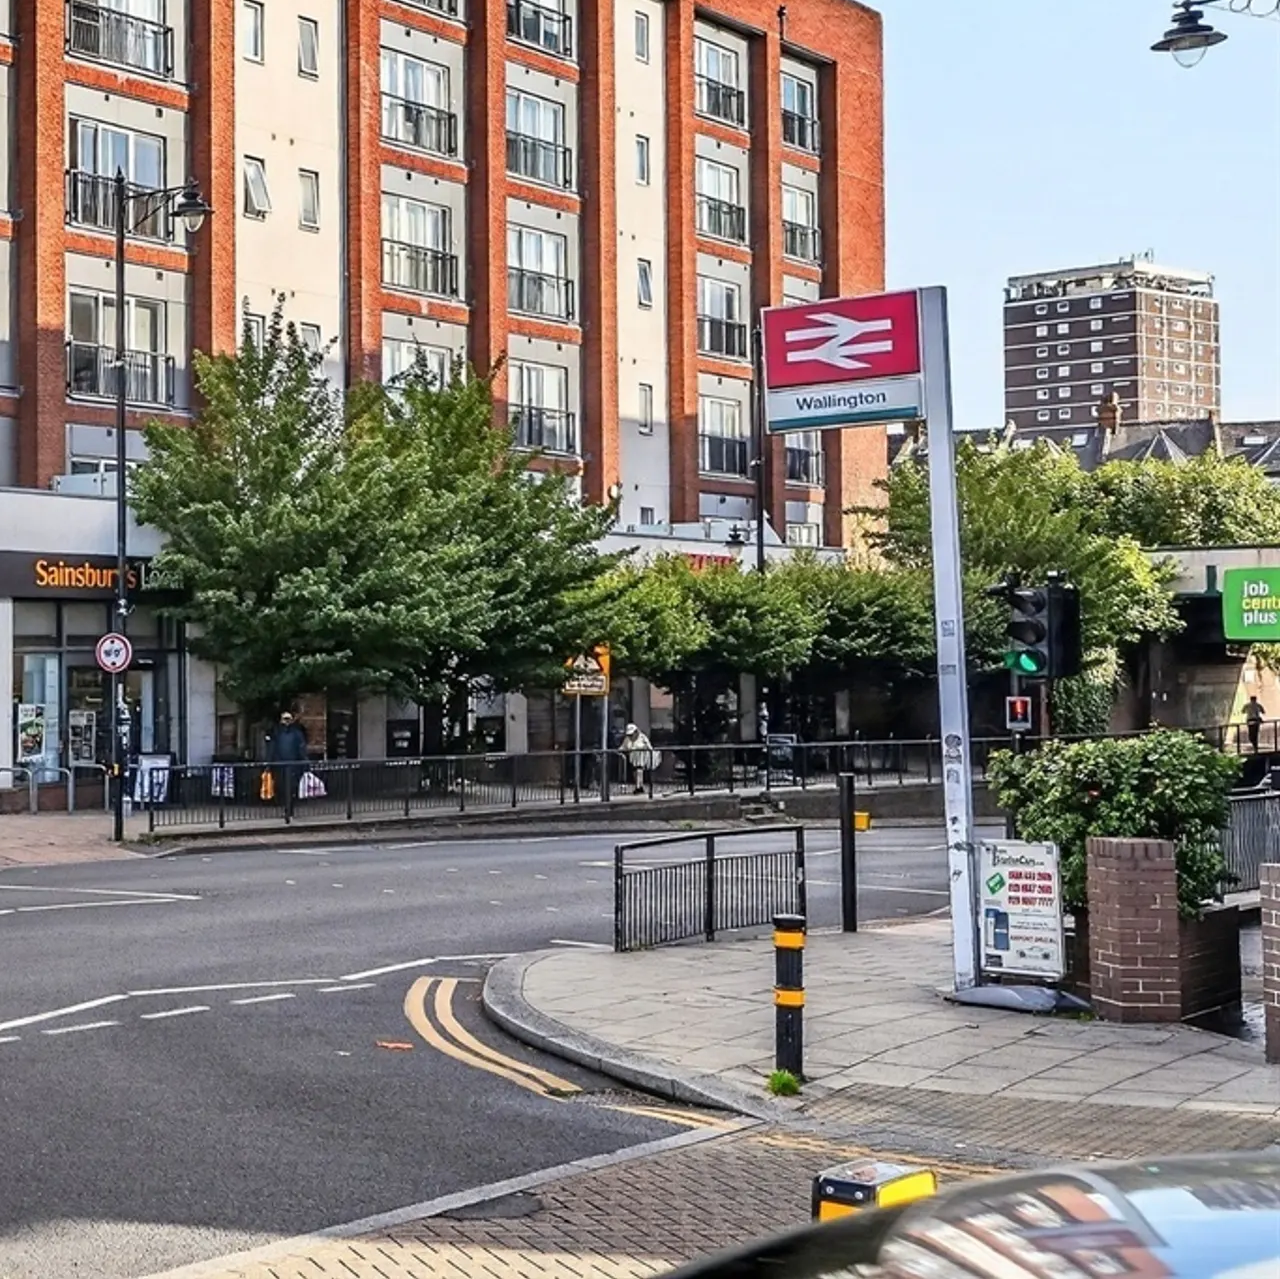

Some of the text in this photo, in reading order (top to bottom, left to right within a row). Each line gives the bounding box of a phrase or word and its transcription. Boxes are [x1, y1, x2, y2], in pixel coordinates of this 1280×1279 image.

[796, 392, 887, 411] Wallington
[1243, 580, 1269, 598] job
[1242, 596, 1280, 610] cent
[1243, 609, 1277, 627] plus
